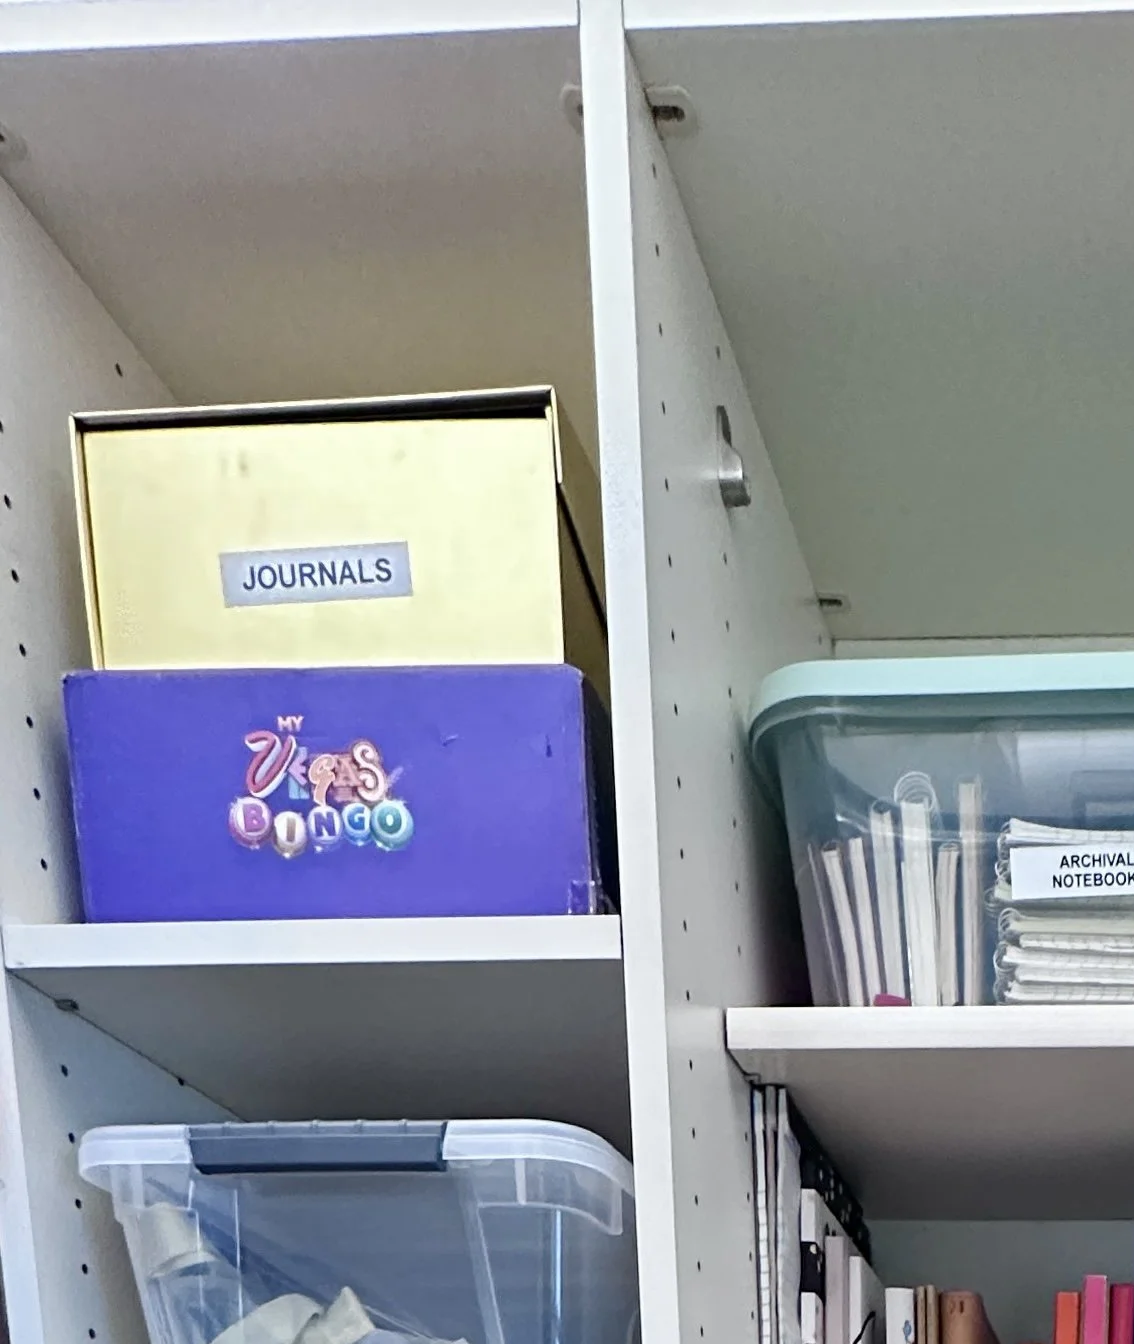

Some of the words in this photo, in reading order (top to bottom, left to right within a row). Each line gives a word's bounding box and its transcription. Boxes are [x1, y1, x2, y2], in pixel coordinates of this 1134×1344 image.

[242, 557, 393, 592] JOURNALS
[276, 715, 304, 732] MY
[240, 799, 404, 844] BINGO
